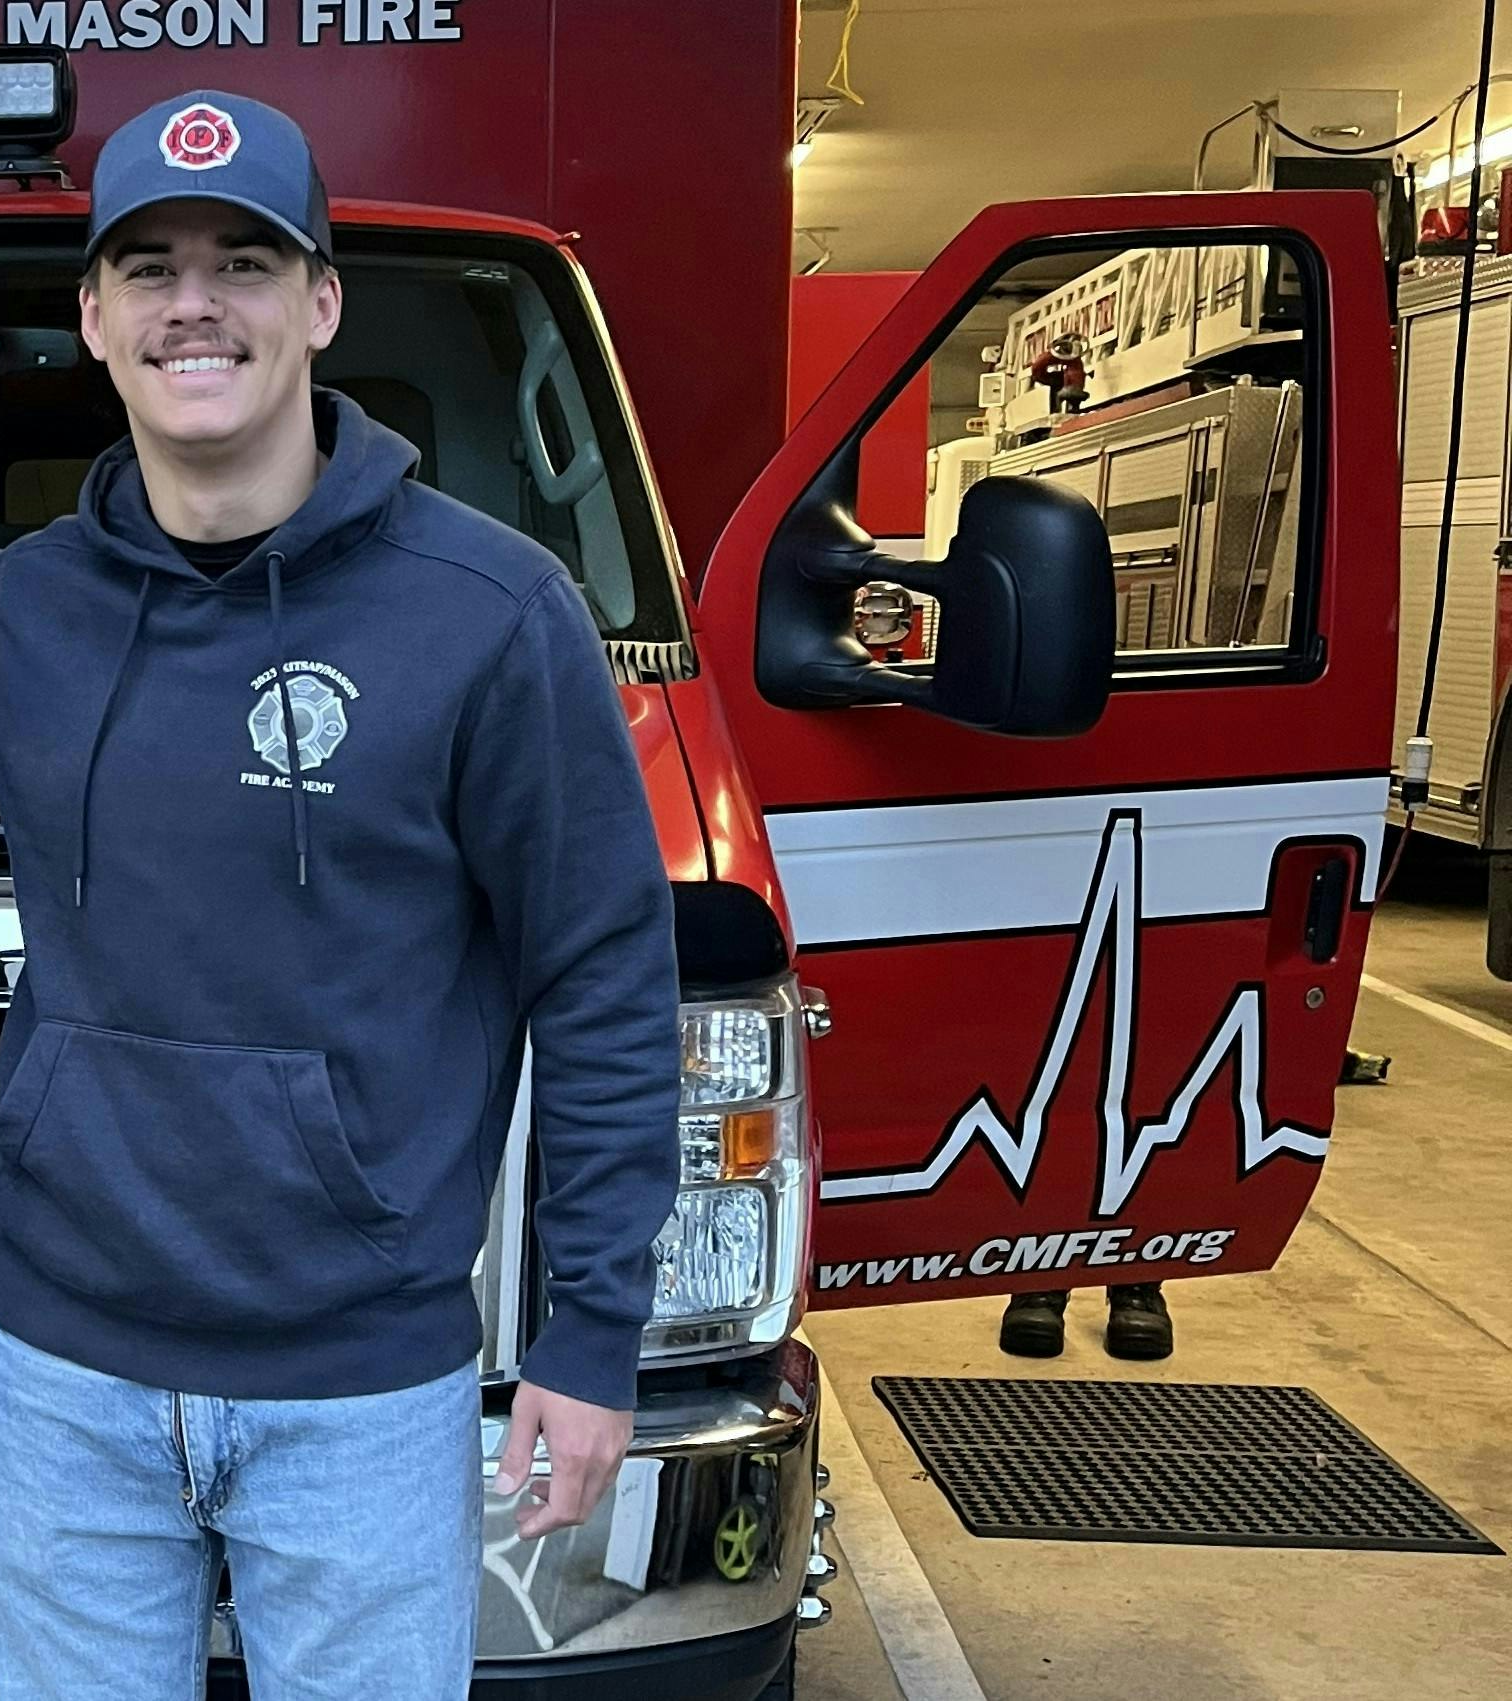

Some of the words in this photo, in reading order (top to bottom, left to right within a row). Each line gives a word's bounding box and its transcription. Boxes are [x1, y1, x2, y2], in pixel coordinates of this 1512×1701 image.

[6, 0, 264, 49] MASON
[301, 0, 462, 44] FIRE
[250, 667, 277, 690] 2023
[240, 772, 270, 786] FIRE
[272, 777, 335, 793] ACEMY
[819, 1228, 1235, 1289] www.CMFE.org
